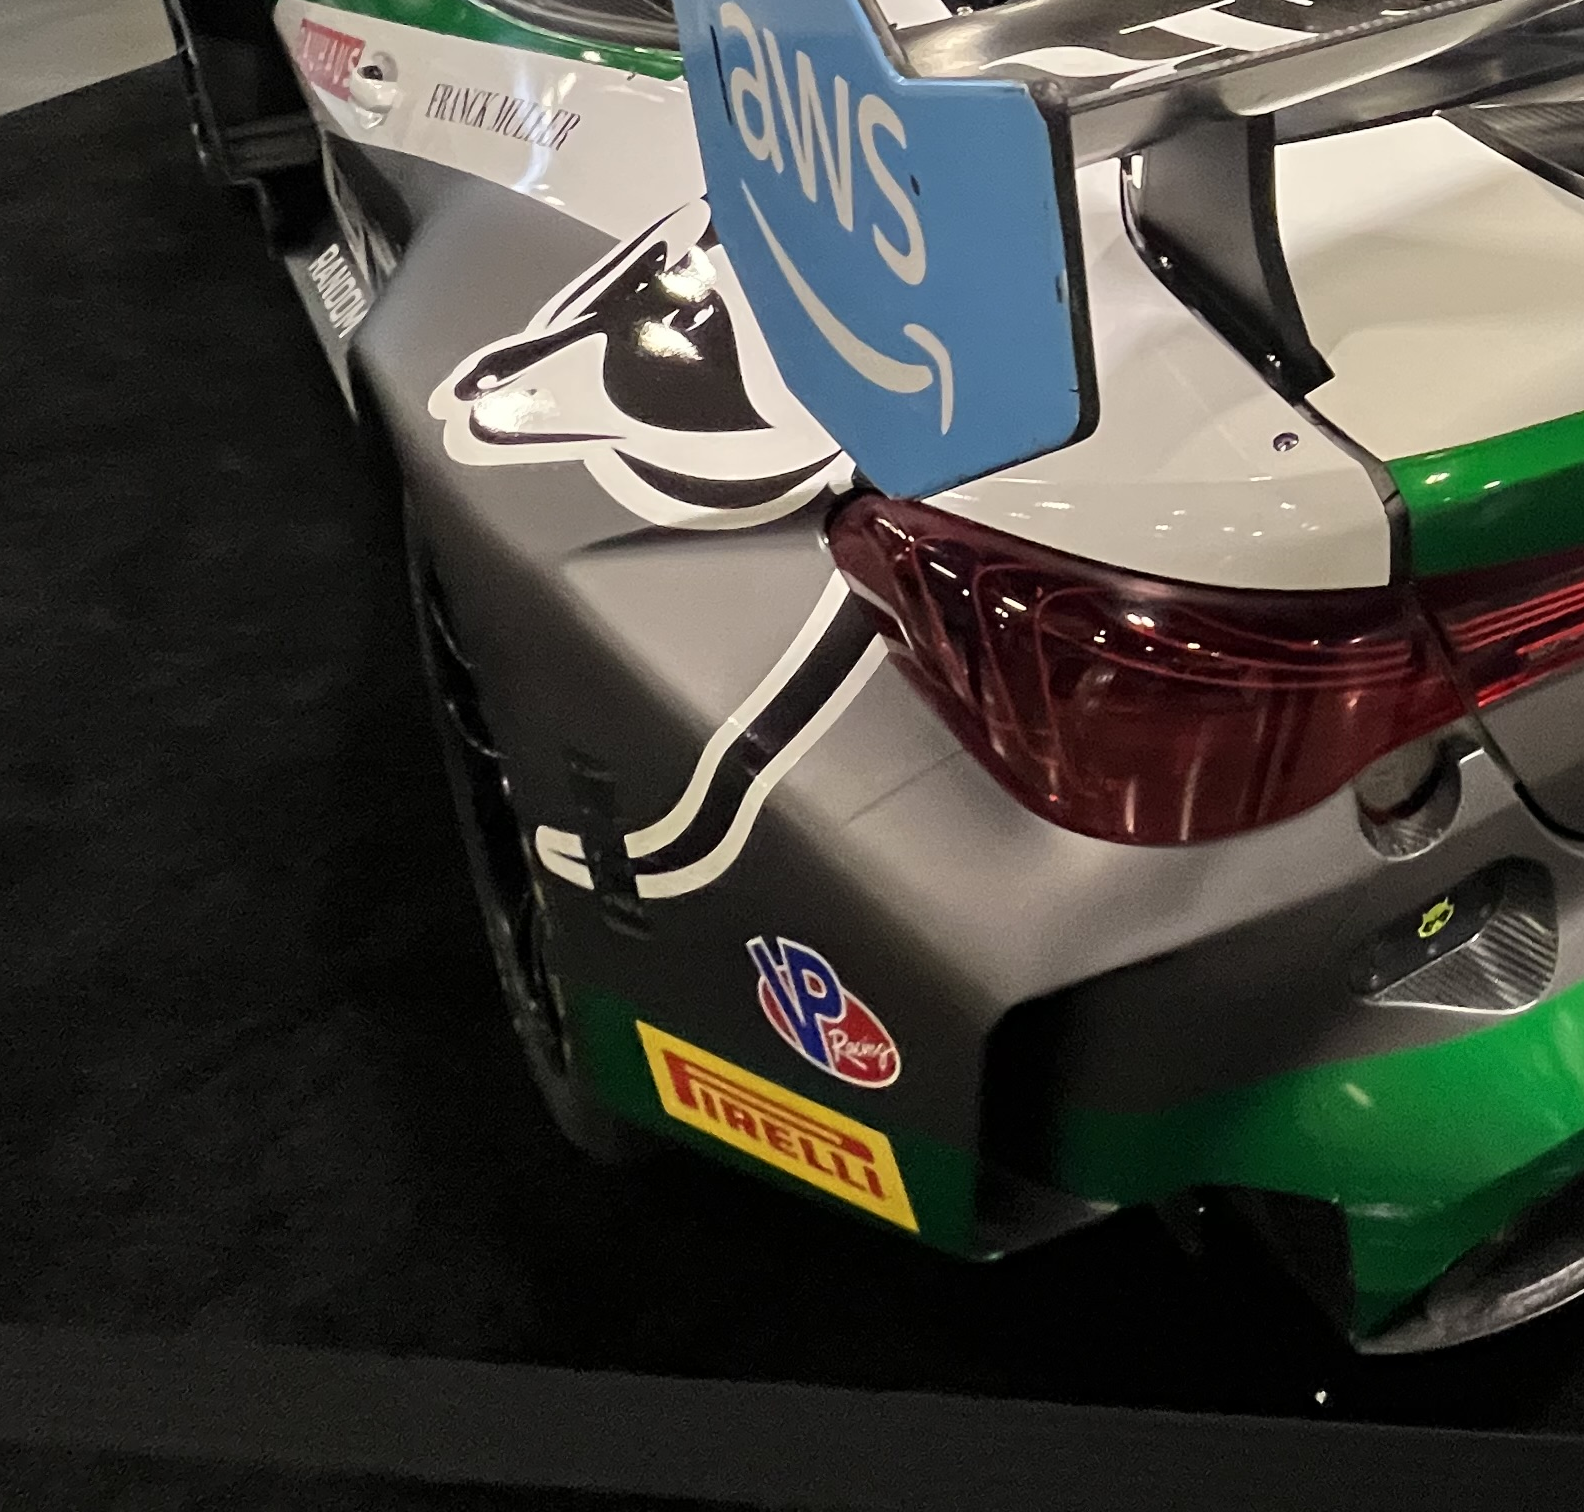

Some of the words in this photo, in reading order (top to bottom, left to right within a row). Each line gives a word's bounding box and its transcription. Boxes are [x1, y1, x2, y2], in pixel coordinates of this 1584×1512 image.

[425, 83, 499, 128] FRANCK
[489, 90, 581, 150] MULLER
[718, 1, 926, 285] aws
[308, 243, 370, 339] RANDOM
[746, 935, 846, 1071] VP
[662, 1049, 886, 1201] PIRELLI
